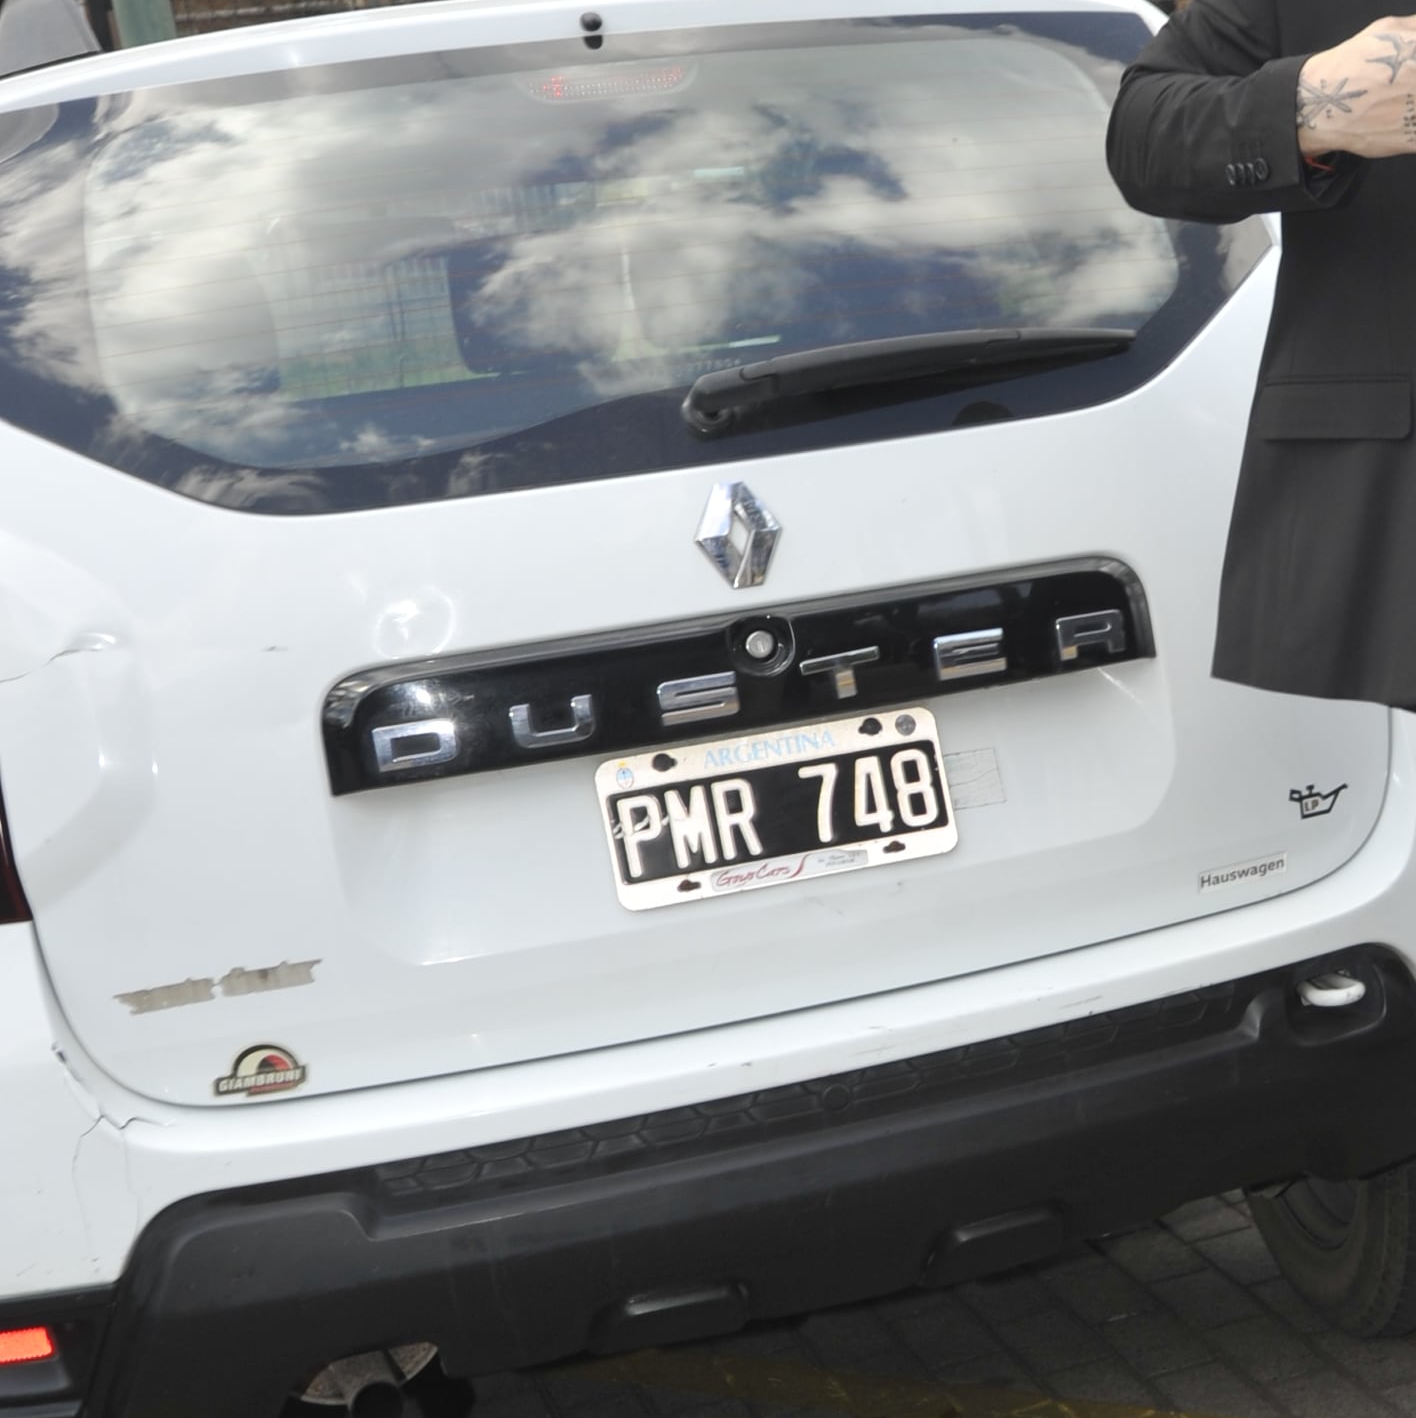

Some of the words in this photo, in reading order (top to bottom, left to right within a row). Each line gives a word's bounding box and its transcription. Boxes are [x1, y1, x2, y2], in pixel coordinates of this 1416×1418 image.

[371, 607, 1126, 774] DUSTER
[703, 728, 836, 770] ARGENTINA
[616, 777, 763, 879] PMR
[797, 747, 941, 844] 748
[1199, 857, 1286, 889] Hauswagen
[219, 1068, 302, 1092] GIAMBRUNI
